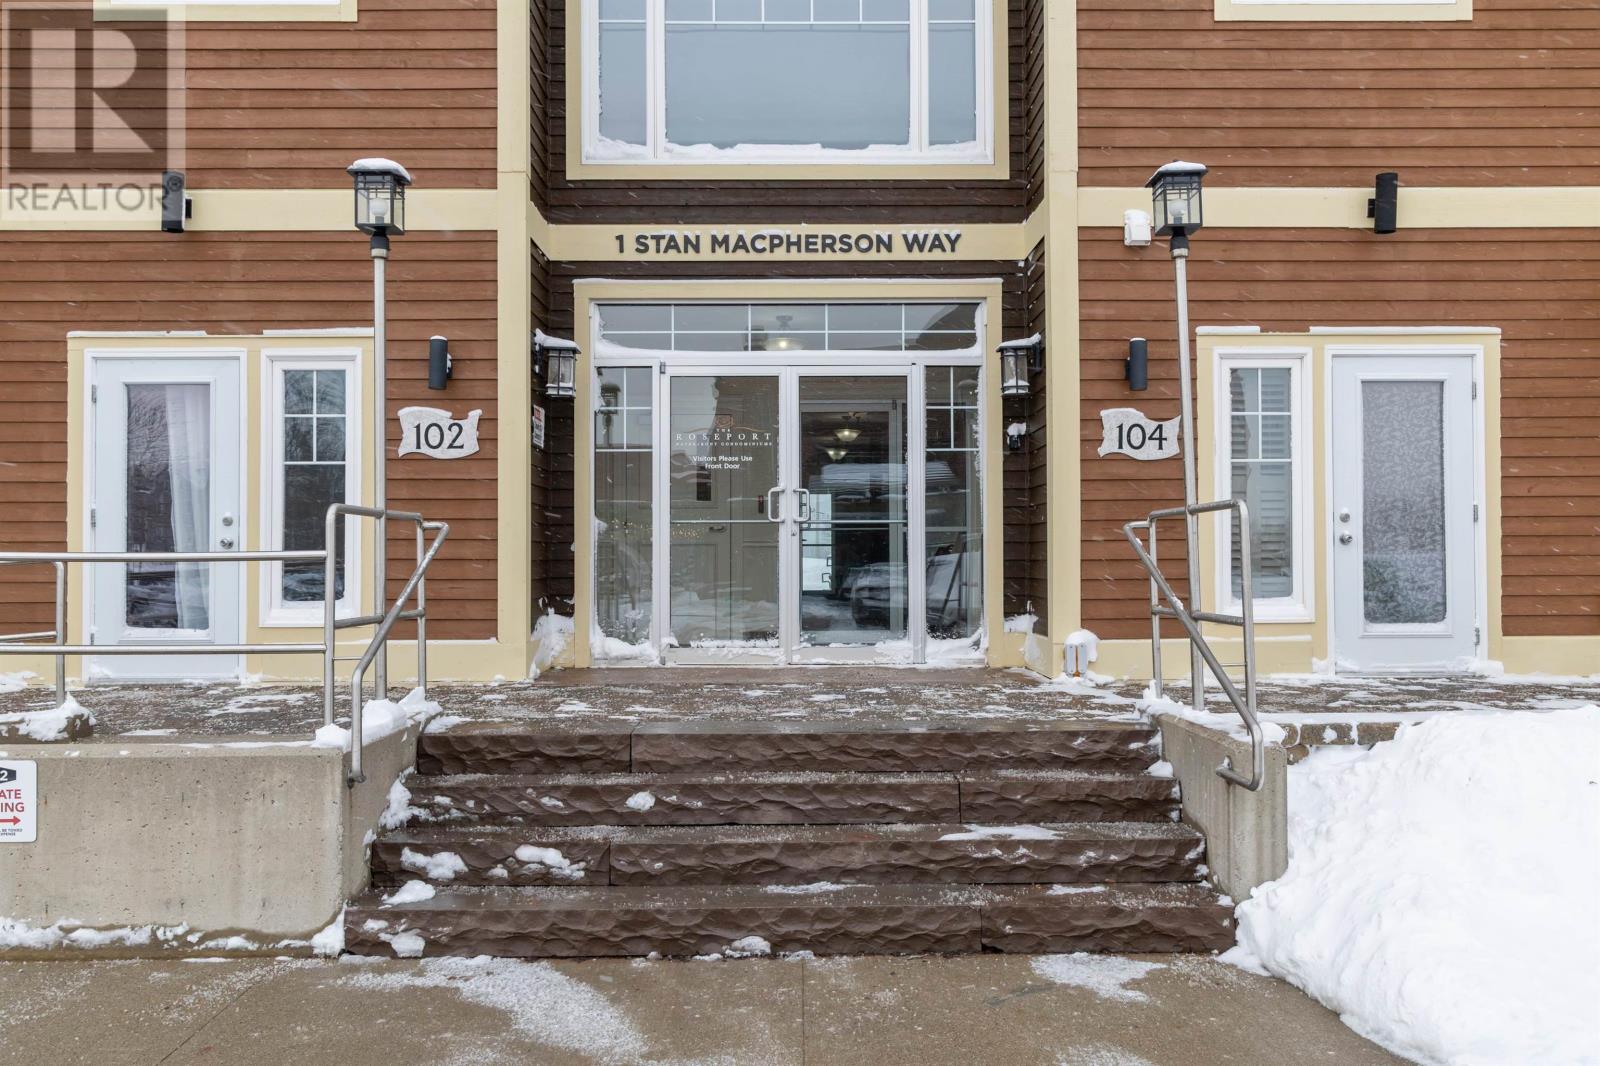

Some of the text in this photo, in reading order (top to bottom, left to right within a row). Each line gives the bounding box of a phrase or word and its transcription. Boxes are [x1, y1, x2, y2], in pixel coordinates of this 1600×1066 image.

[615, 233, 962, 254] 1 STAN MACPHERSON WAY
[413, 422, 465, 450] 102
[675, 433, 772, 441] ROSEPORT
[1116, 423, 1168, 450] 104
